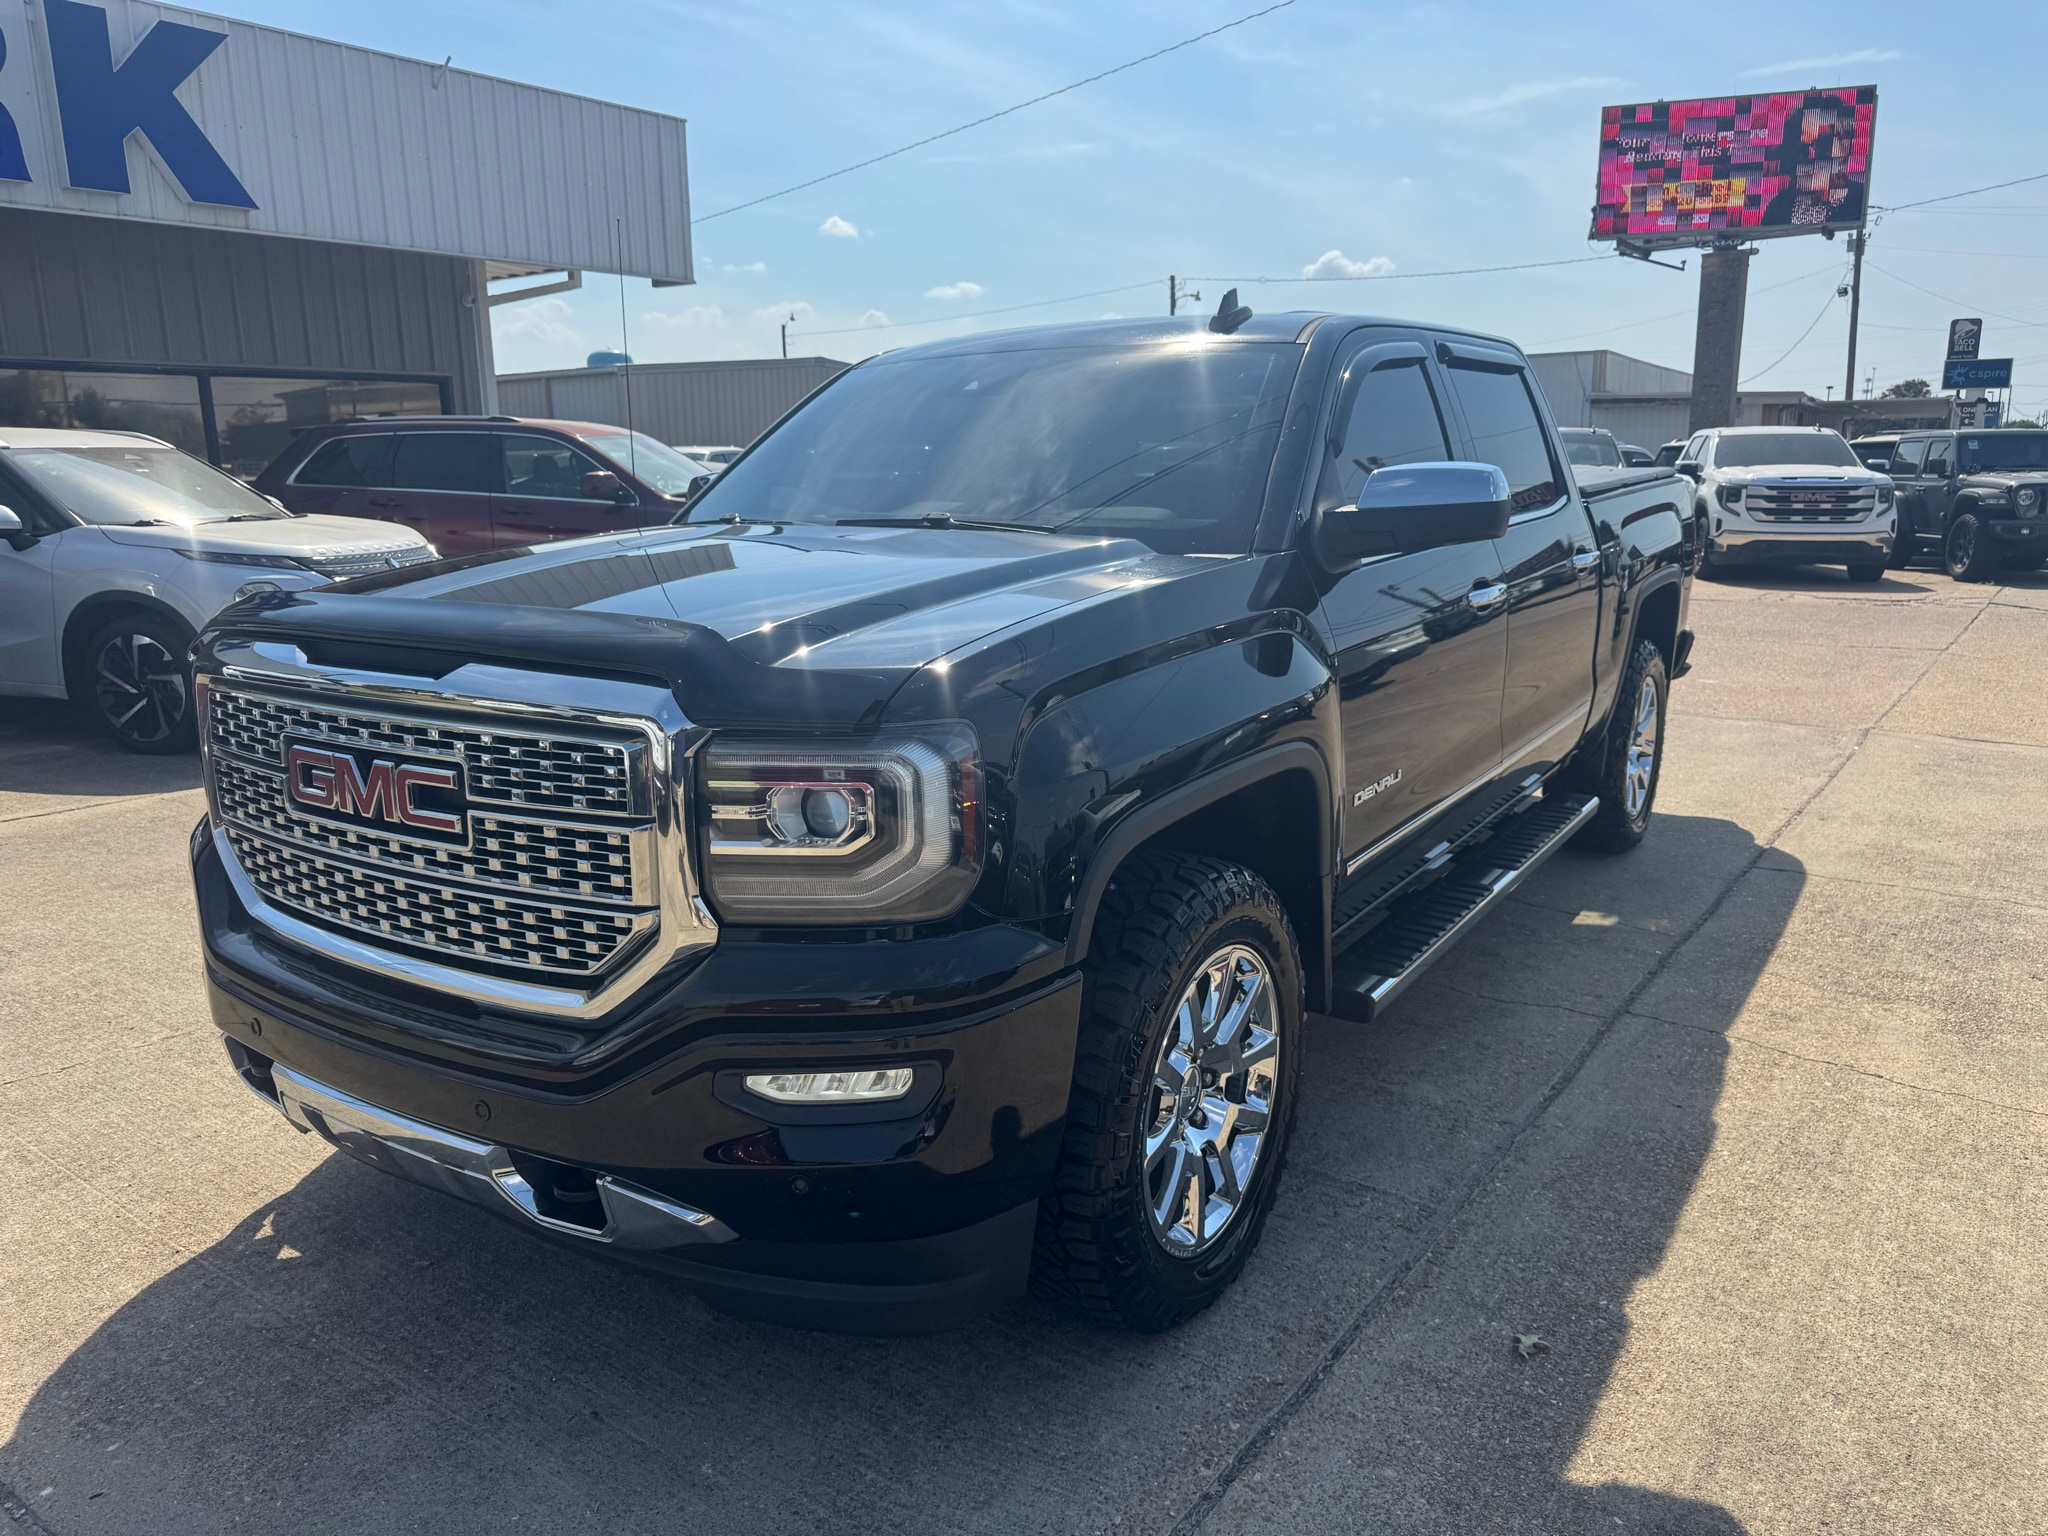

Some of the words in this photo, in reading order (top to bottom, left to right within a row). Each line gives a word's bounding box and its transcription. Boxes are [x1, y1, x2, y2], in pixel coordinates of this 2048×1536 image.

[0, 0, 260, 210] K
[1790, 491, 1836, 501] GMC
[288, 744, 462, 833] GMC
[1352, 768, 1402, 807] DENALI
